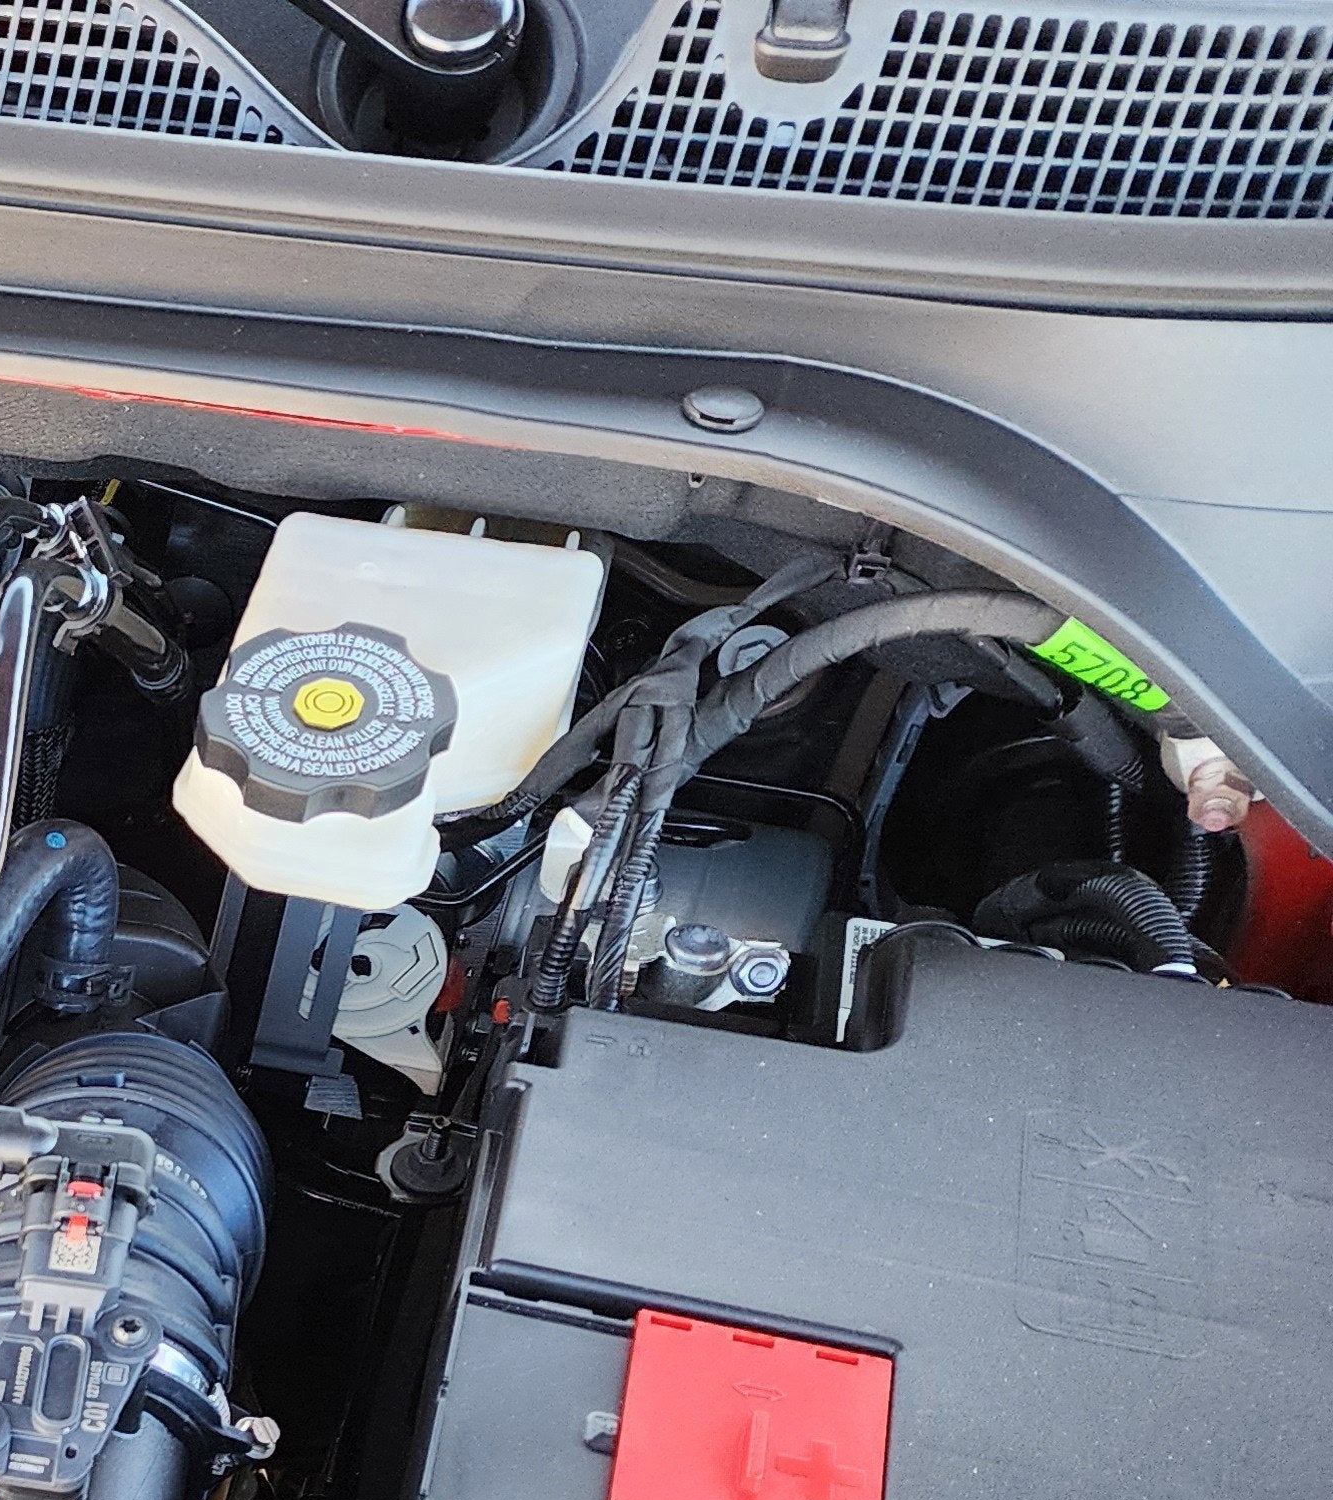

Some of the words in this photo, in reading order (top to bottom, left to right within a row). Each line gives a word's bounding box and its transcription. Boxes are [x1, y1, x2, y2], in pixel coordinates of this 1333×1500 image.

[337, 633, 354, 646] LE
[1049, 641, 1152, 701] 5708
[225, 693, 244, 715] DOT
[244, 694, 262, 715] CAP
[229, 720, 261, 749] FLUID
[248, 714, 287, 749] BEFORE
[299, 732, 345, 748] CLEAN
[345, 719, 387, 746] FILLER
[374, 723, 405, 750] ONLY
[252, 742, 293, 769] FROM
[301, 761, 357, 776] SEALED
